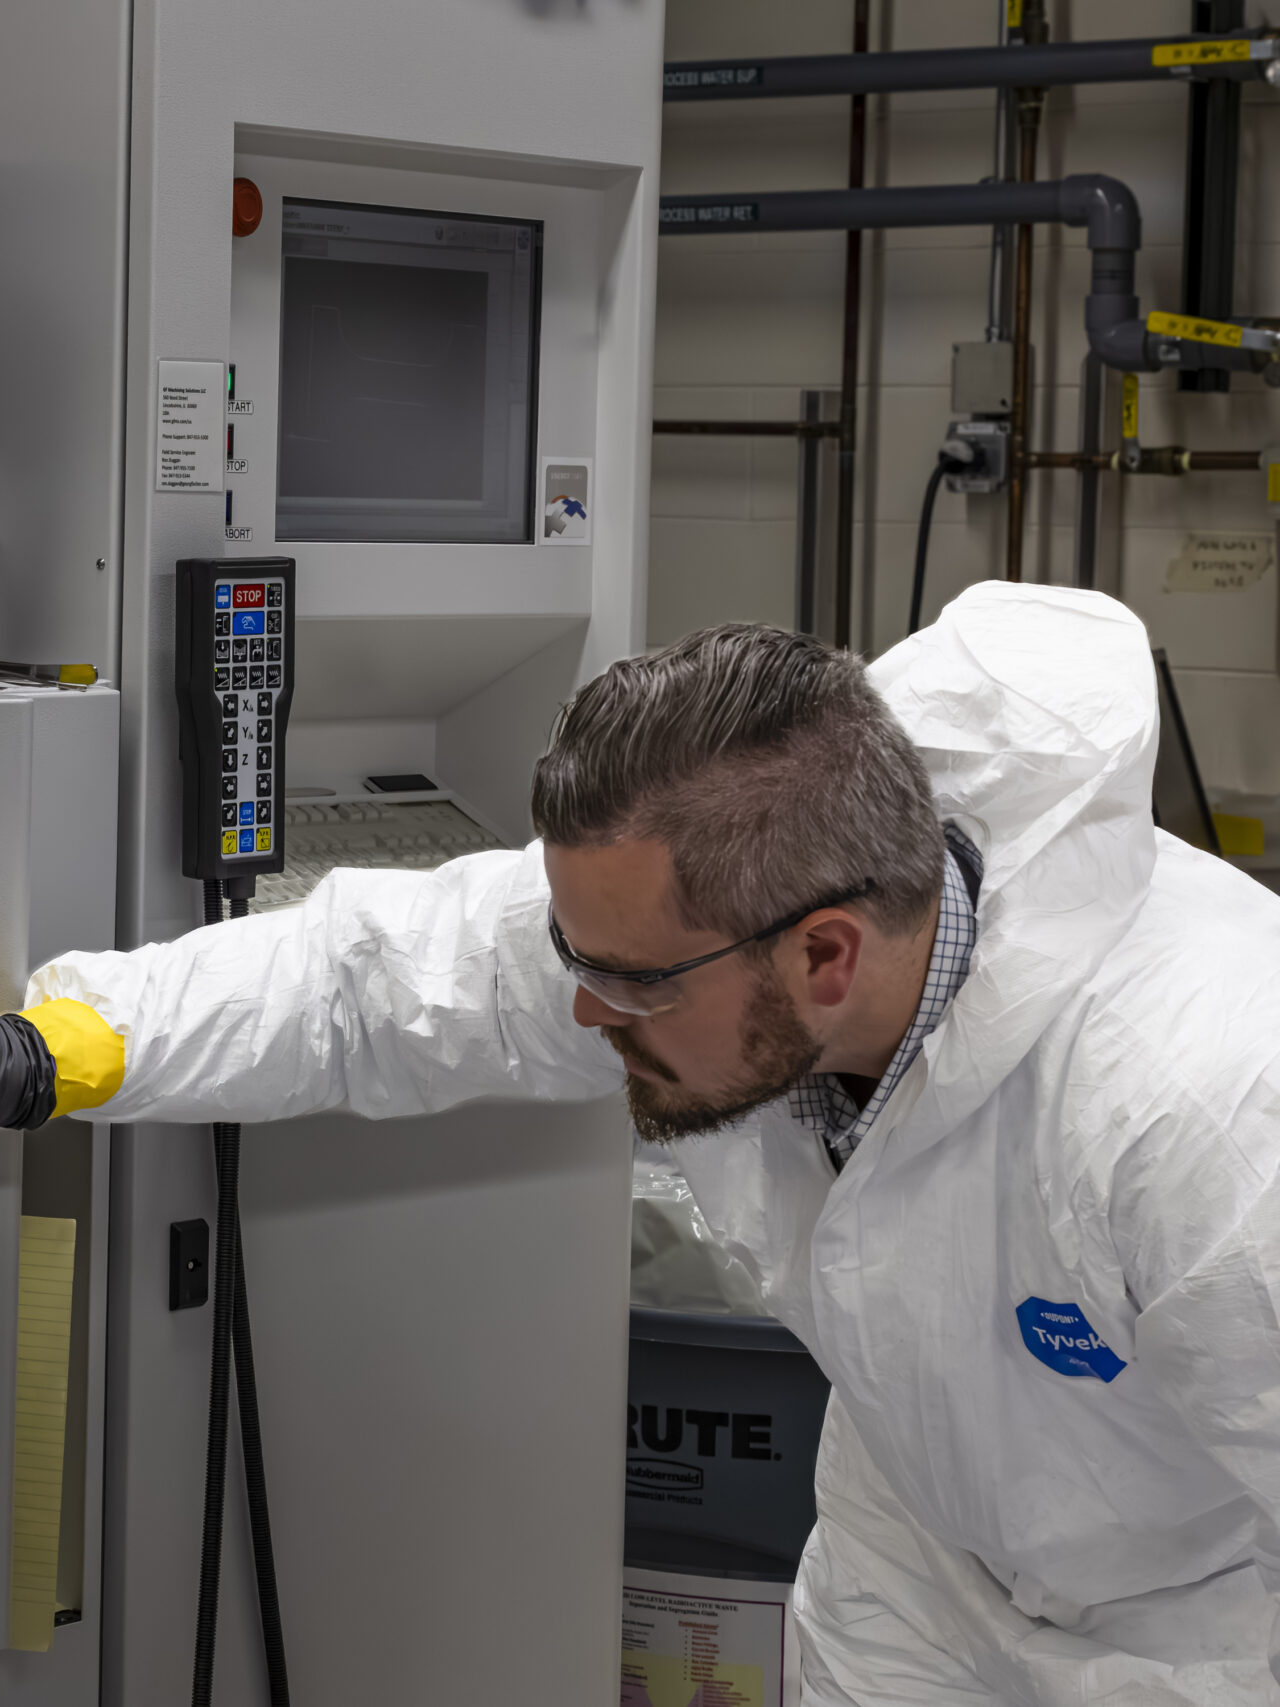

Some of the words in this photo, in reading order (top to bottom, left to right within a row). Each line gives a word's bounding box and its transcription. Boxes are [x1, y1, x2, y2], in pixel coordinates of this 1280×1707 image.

[236, 590, 262, 603] STOP
[242, 754, 248, 765] Z
[1032, 1326, 1108, 1350] Tyvek
